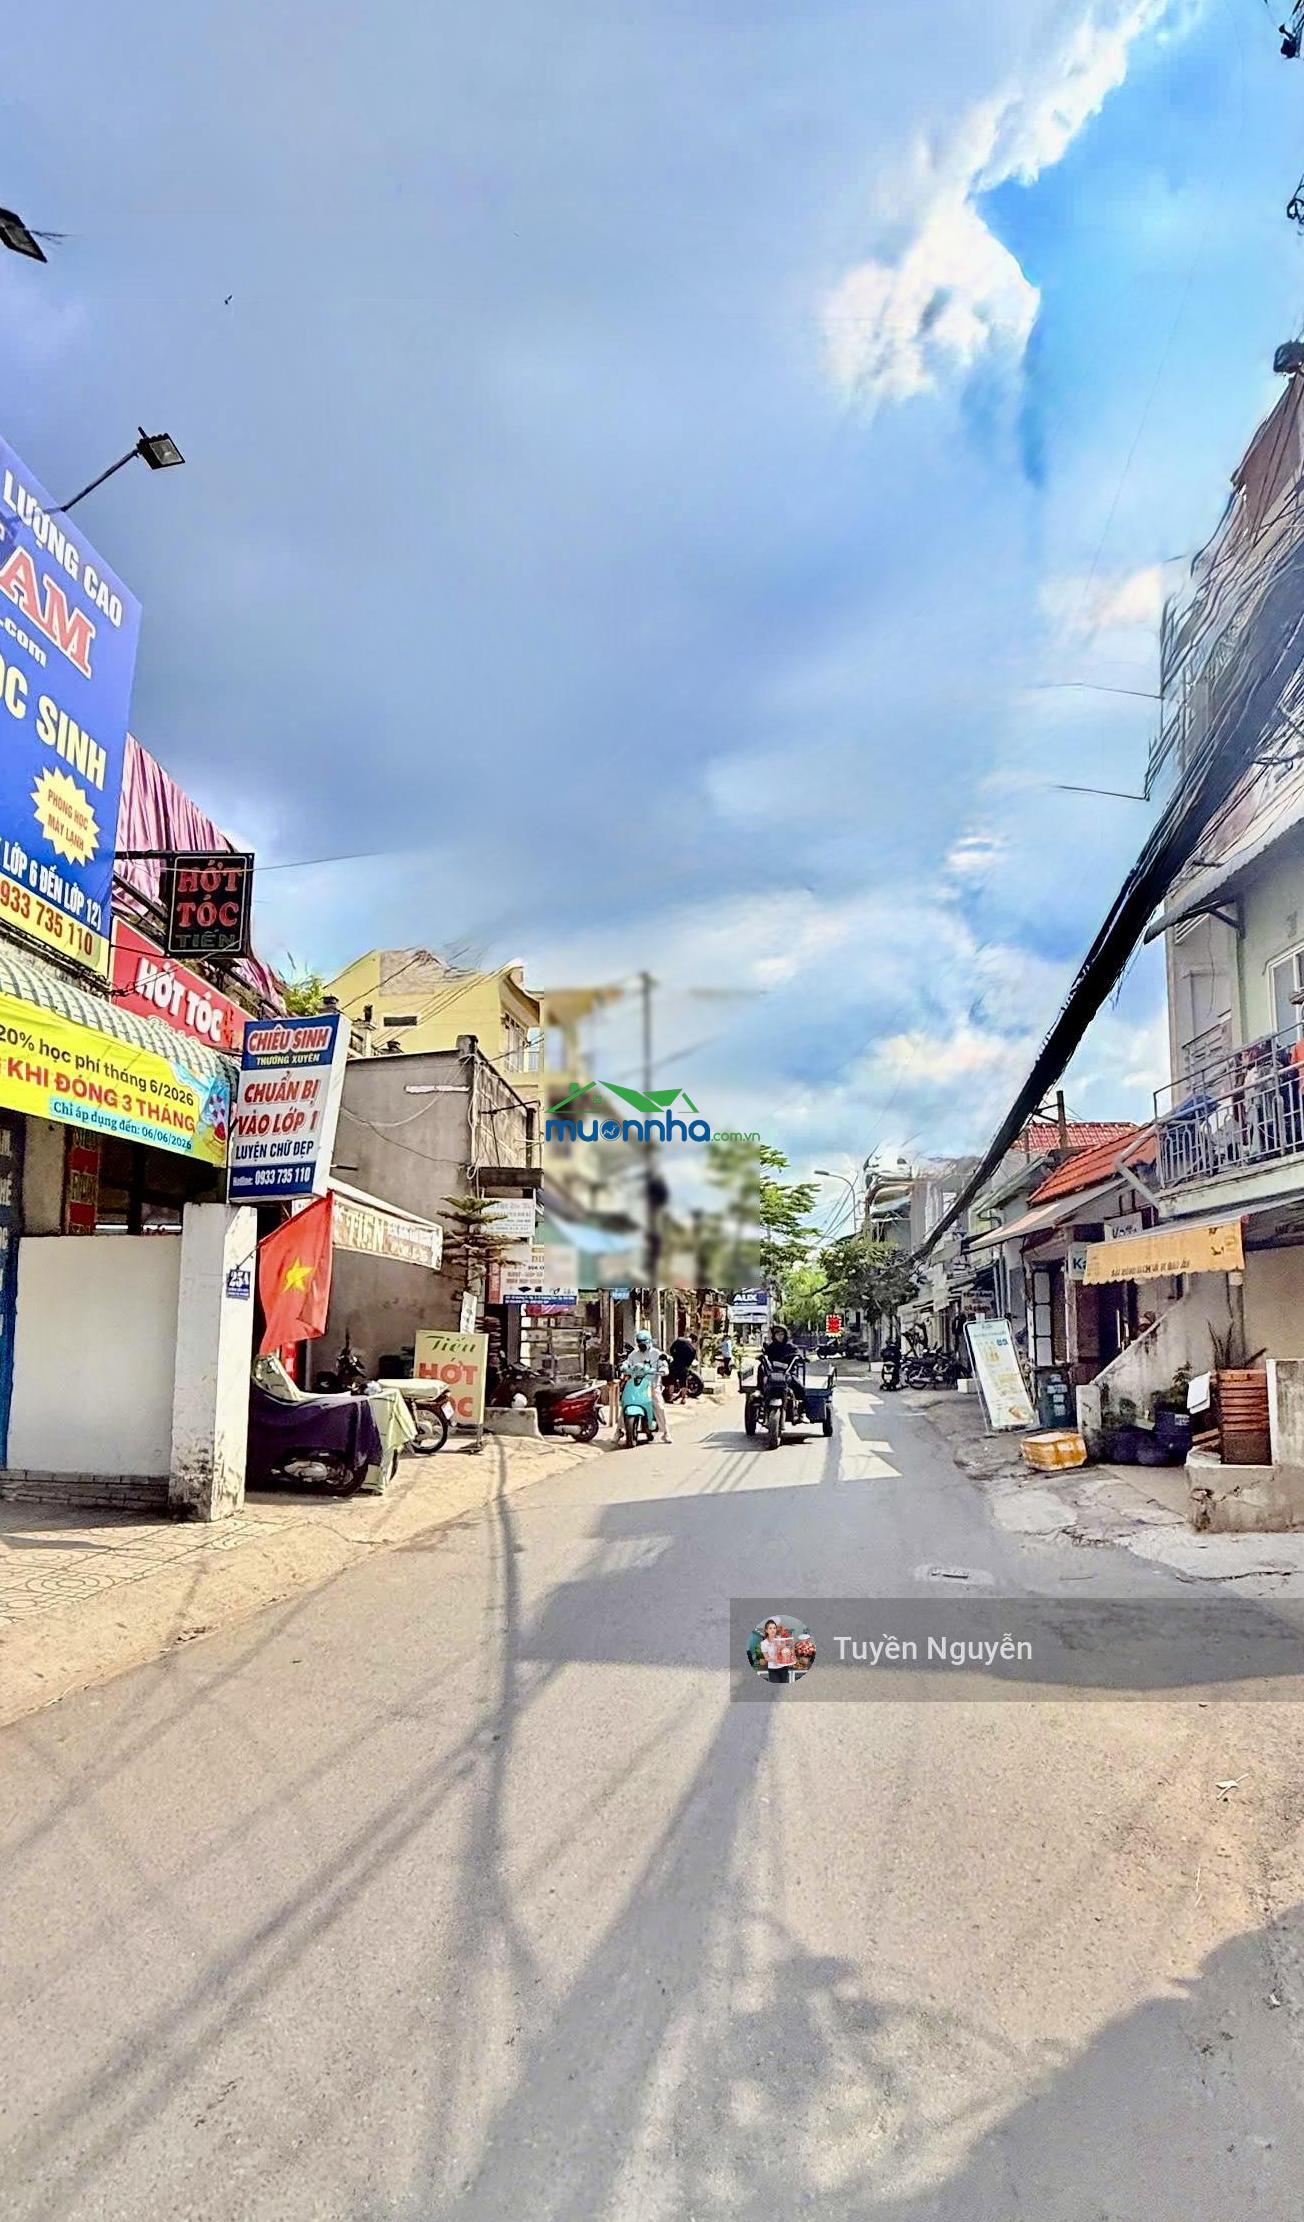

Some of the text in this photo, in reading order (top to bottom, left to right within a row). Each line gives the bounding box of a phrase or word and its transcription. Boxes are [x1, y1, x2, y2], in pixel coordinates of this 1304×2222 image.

[4, 468, 123, 628] LƯỢNG CAO
[36, 695, 107, 791] SINH
[3, 841, 28, 878] LỚP
[29, 859, 38, 887] 6
[39, 864, 63, 904] ĐẾN
[64, 882, 85, 915] LỚP
[177, 859, 243, 892] HỚT
[176, 894, 239, 927] TÓC
[36, 900, 63, 938] 735
[68, 922, 93, 956] 110
[175, 929, 236, 948] TIẾN
[135, 957, 187, 1018] HỚT
[186, 991, 223, 1042] TÓC
[248, 1025, 291, 1053] CHIÊU
[292, 1028, 330, 1050] SINH
[39, 1038, 72, 1063] học
[75, 1054, 101, 1073] phí
[104, 1062, 147, 1093] tháng
[149, 1079, 194, 1106] 6/2026
[7, 1056, 196, 1134] KHI ĐÓNG 3 THÁNG
[301, 1079, 319, 1107] BỊ
[75, 1106, 89, 1122] áp
[91, 1112, 118, 1132] dụng
[119, 1119, 141, 1135] đến:
[141, 1126, 192, 1150] 06/06/2026
[272, 1106, 305, 1133] LỚP
[310, 1110, 318, 1131] 1
[235, 1138, 314, 1161] LUYỆN CHỮ ĐẸP
[255, 1169, 275, 1186] 0933
[276, 1168, 293, 1184] 735
[294, 1166, 312, 1182] 110
[733, 1293, 758, 1302] AUX
[425, 1335, 476, 1353] Tiến
[418, 1358, 479, 1385] HỚT
